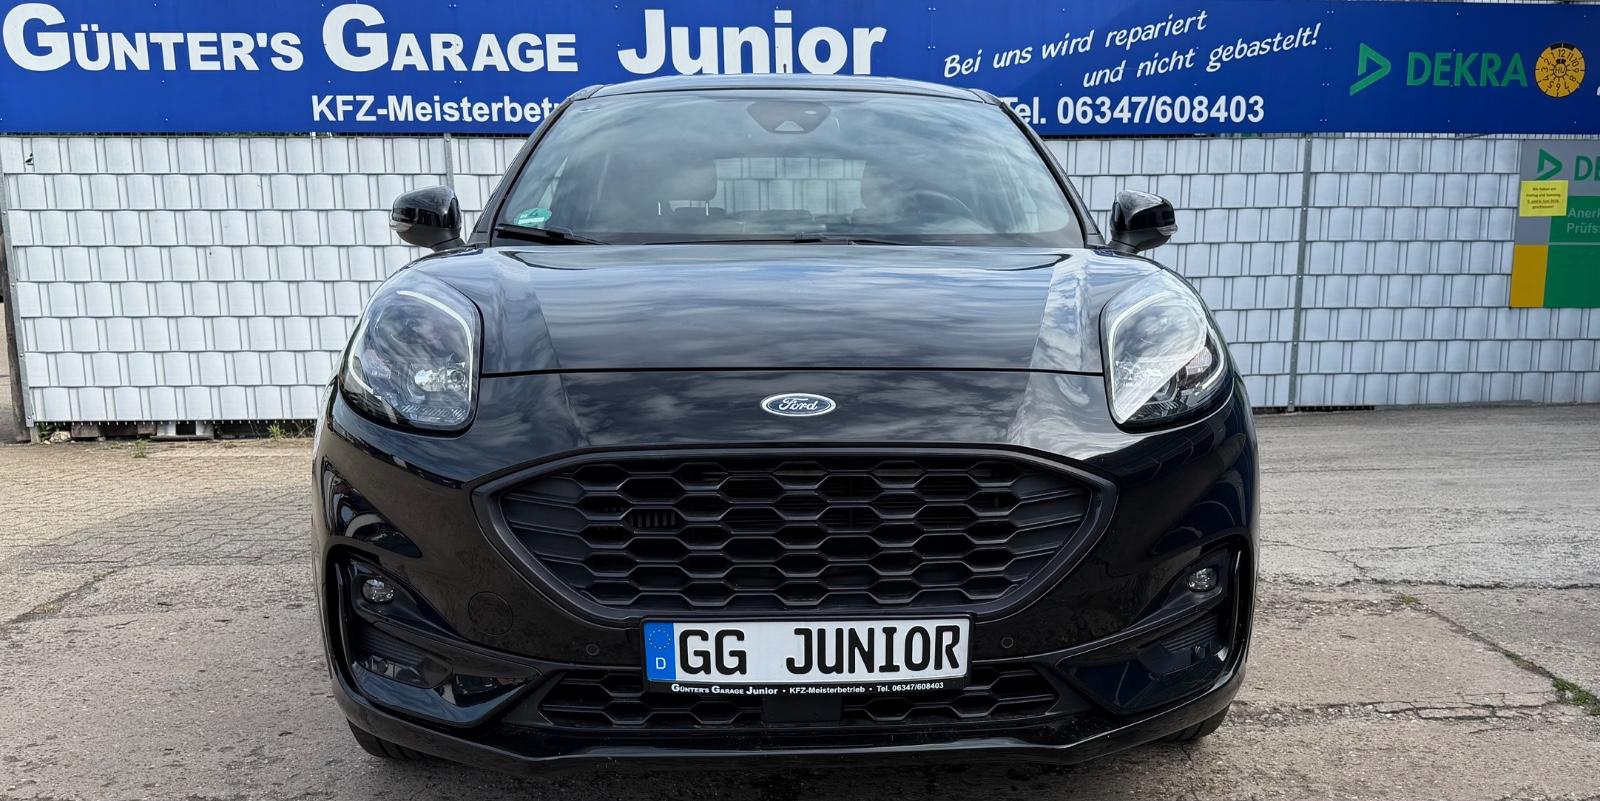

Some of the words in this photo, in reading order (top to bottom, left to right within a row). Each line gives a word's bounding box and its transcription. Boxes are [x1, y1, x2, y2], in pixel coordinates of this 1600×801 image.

[2, 3, 304, 72] GÜNTER'S
[322, 3, 579, 72] GARAGE
[617, 9, 887, 75] Junior
[943, 50, 982, 78] Bei
[993, 47, 1032, 68] uns
[1041, 30, 1095, 60] wird
[1105, 10, 1208, 49] repariert
[1557, 49, 1566, 57] 12
[1082, 61, 1125, 88] und
[1136, 48, 1196, 79] nicht
[1206, 23, 1322, 72] gebastelt!
[1406, 51, 1529, 87] DEKRA
[311, 94, 560, 123] KFZ-Meisterbet
[1056, 95, 1265, 124] 06347/608403
[1567, 207, 1600, 218] Aner
[1566, 222, 1600, 234] Prüfs
[778, 397, 819, 411] Ford
[655, 657, 666, 670] D
[678, 629, 748, 676] GG
[785, 624, 961, 675] JUNIOR
[671, 683, 710, 694] GÜNTER'S
[711, 685, 744, 694] GARAGE
[746, 686, 779, 695] Junior
[789, 686, 866, 695] KFZ-Meisterbetrieb
[876, 685, 890, 693] Tel.
[891, 681, 945, 692] 06347/608403
